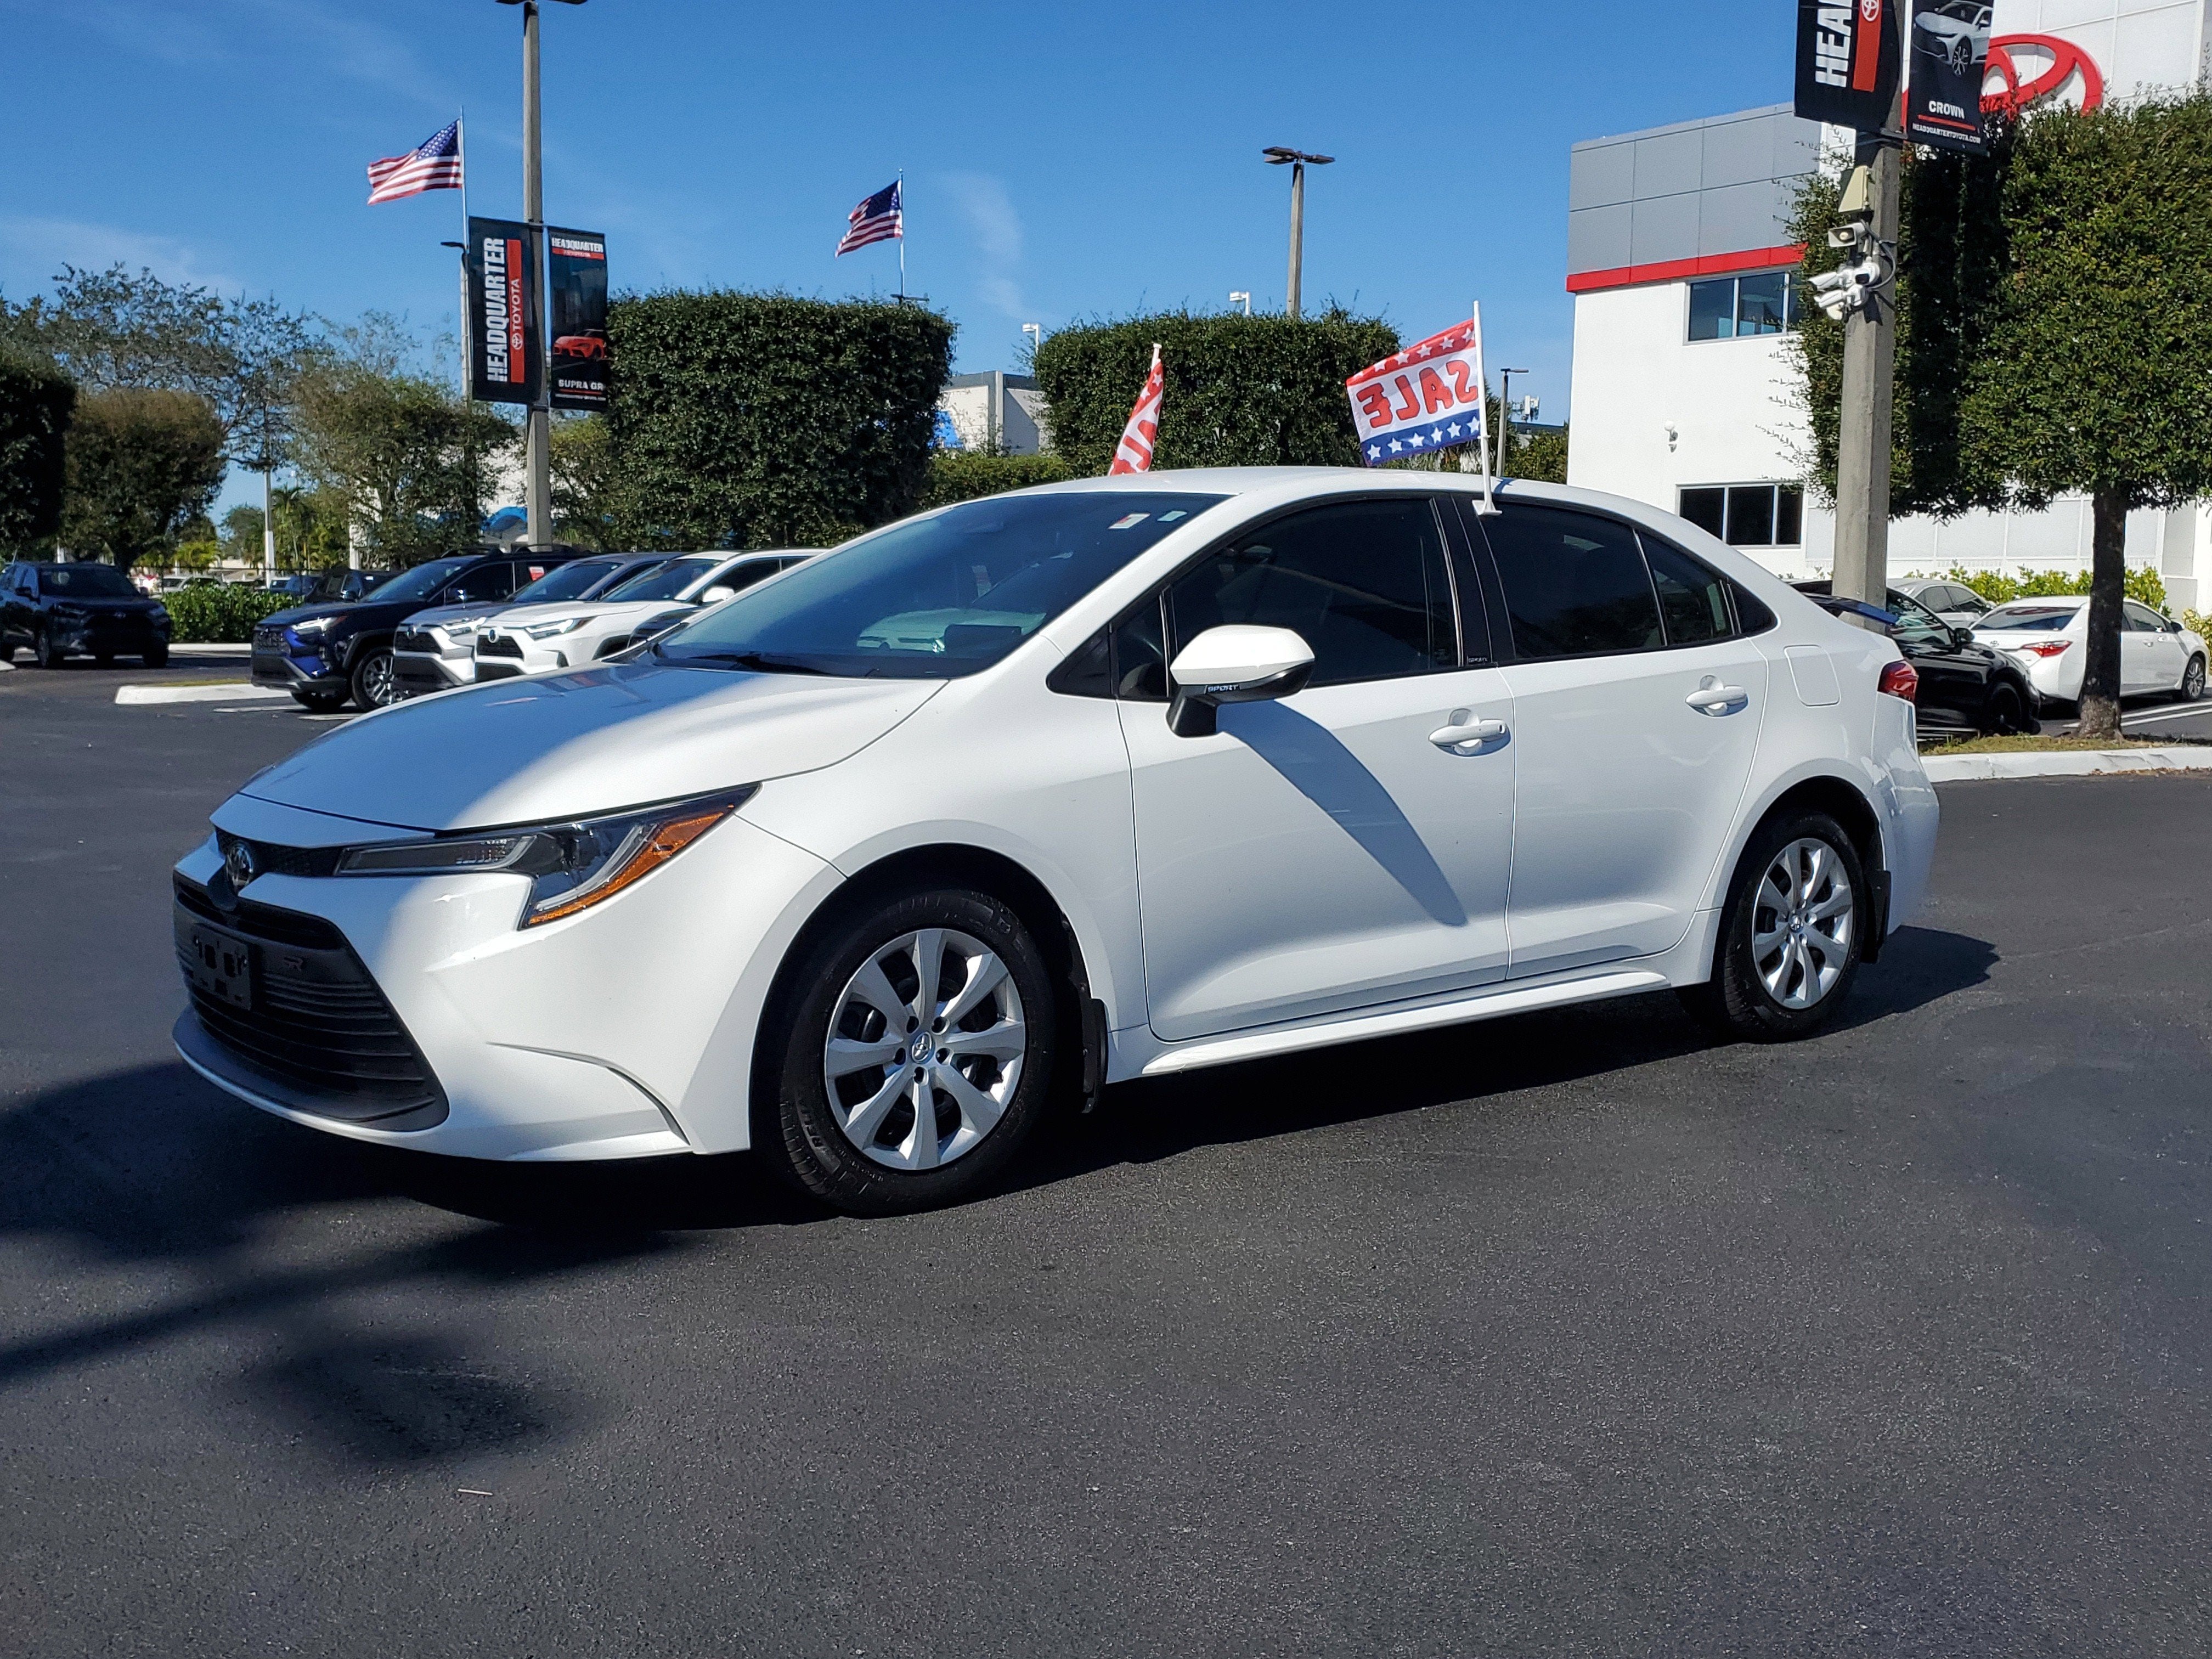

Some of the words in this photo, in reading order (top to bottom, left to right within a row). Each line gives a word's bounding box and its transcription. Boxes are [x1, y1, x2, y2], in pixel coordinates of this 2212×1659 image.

[1815, 0, 1852, 88] HEA
[1928, 100, 1965, 119] CROWN
[1912, 123, 1981, 144] HEADQUARTERTOYOTA.COM
[551, 237, 603, 252] HEADQUARTER
[484, 238, 509, 382] HEADQUARTER
[511, 278, 522, 331] TOYOTA
[558, 379, 589, 390] SUPRA
